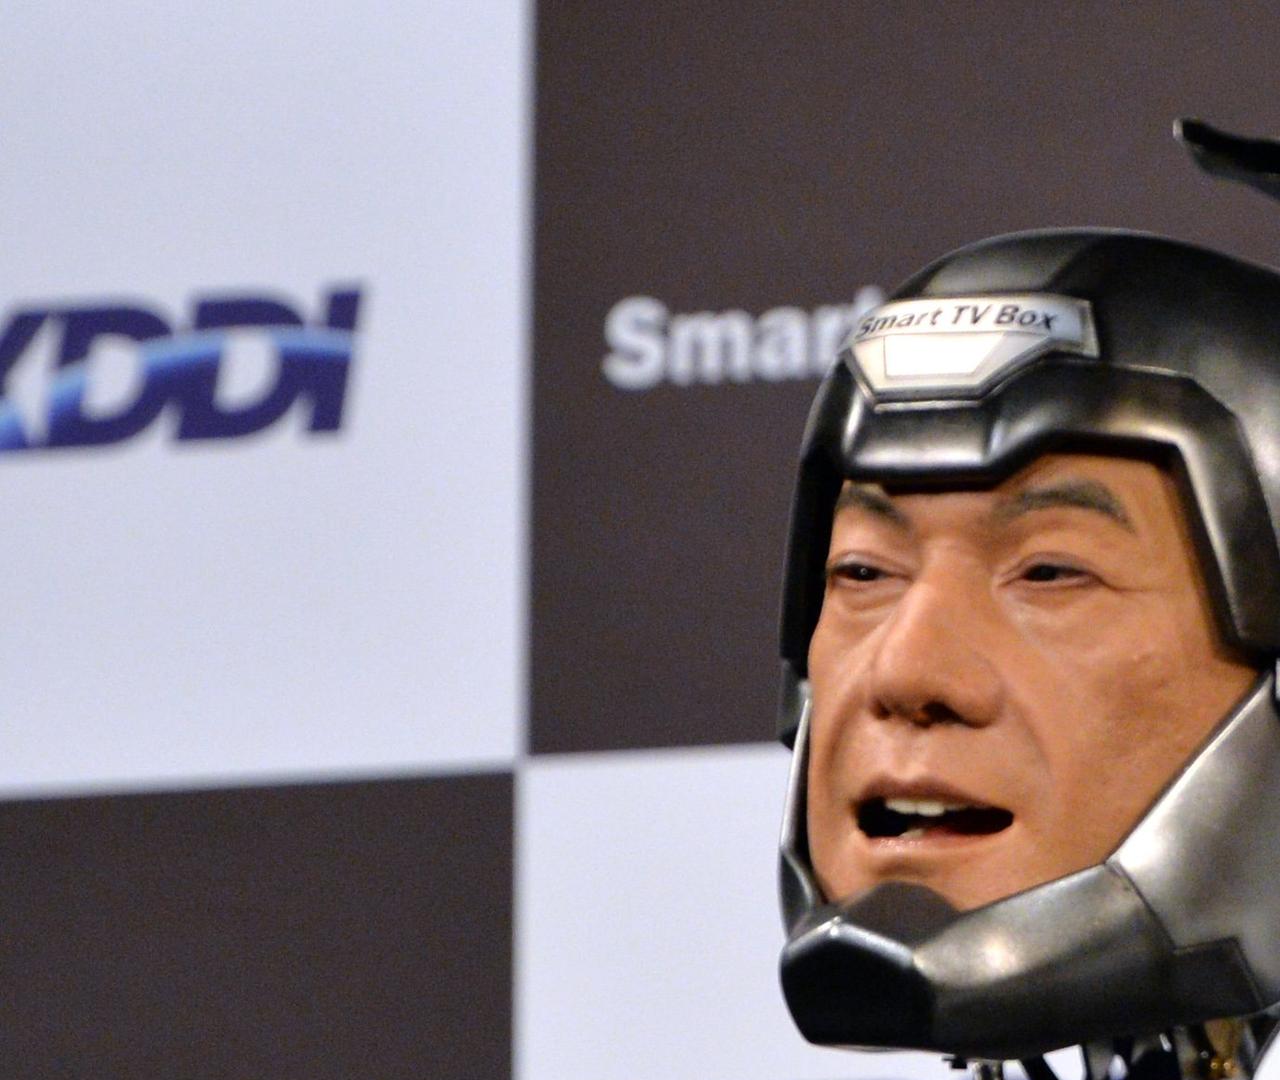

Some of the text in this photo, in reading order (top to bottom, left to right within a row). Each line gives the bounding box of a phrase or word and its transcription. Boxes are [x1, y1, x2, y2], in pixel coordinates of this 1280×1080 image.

[602, 285, 886, 389] Smar
[856, 304, 1057, 338] Smart TV Box
